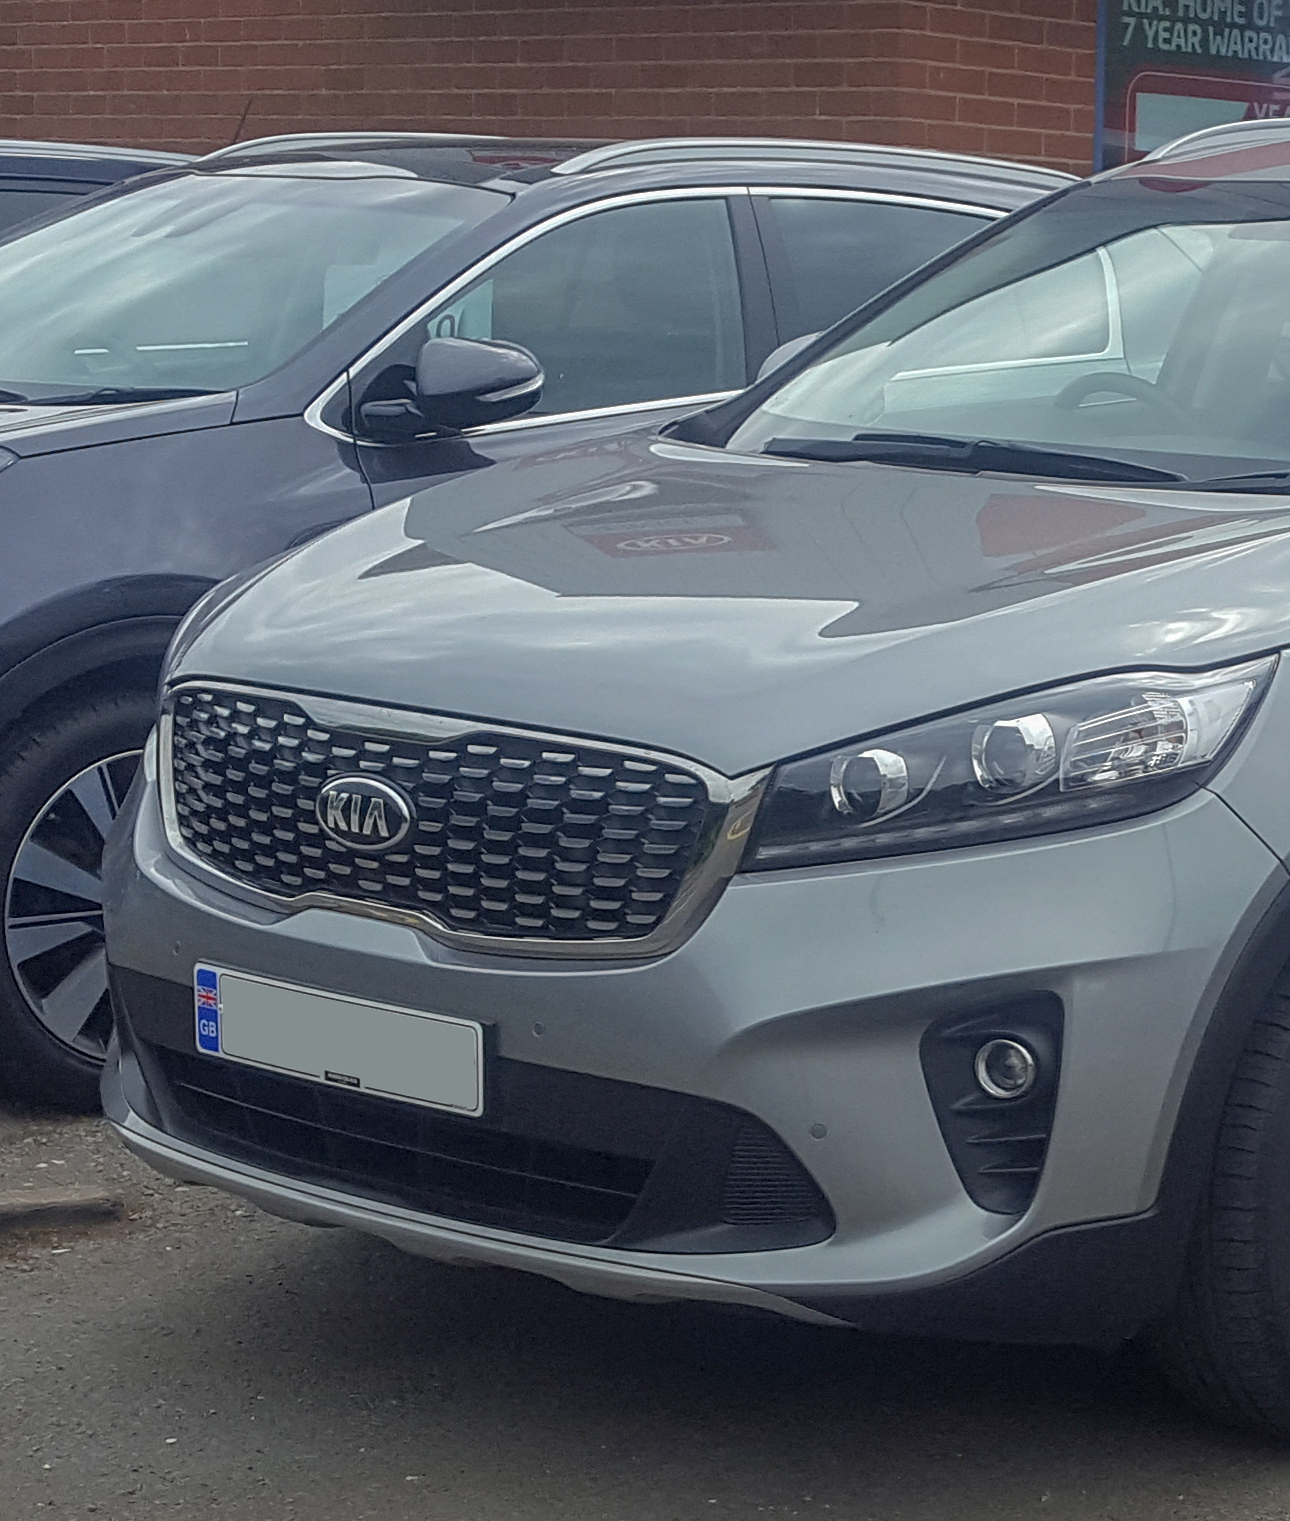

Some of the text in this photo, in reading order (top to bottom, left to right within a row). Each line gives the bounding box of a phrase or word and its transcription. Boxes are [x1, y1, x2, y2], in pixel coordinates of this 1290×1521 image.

[1178, 0, 1246, 24] HOME
[1253, 0, 1283, 27] OF
[1121, 16, 1137, 46] 7
[1142, 18, 1202, 54] YEAR
[327, 790, 390, 837] KIA
[199, 1019, 218, 1038] GB
